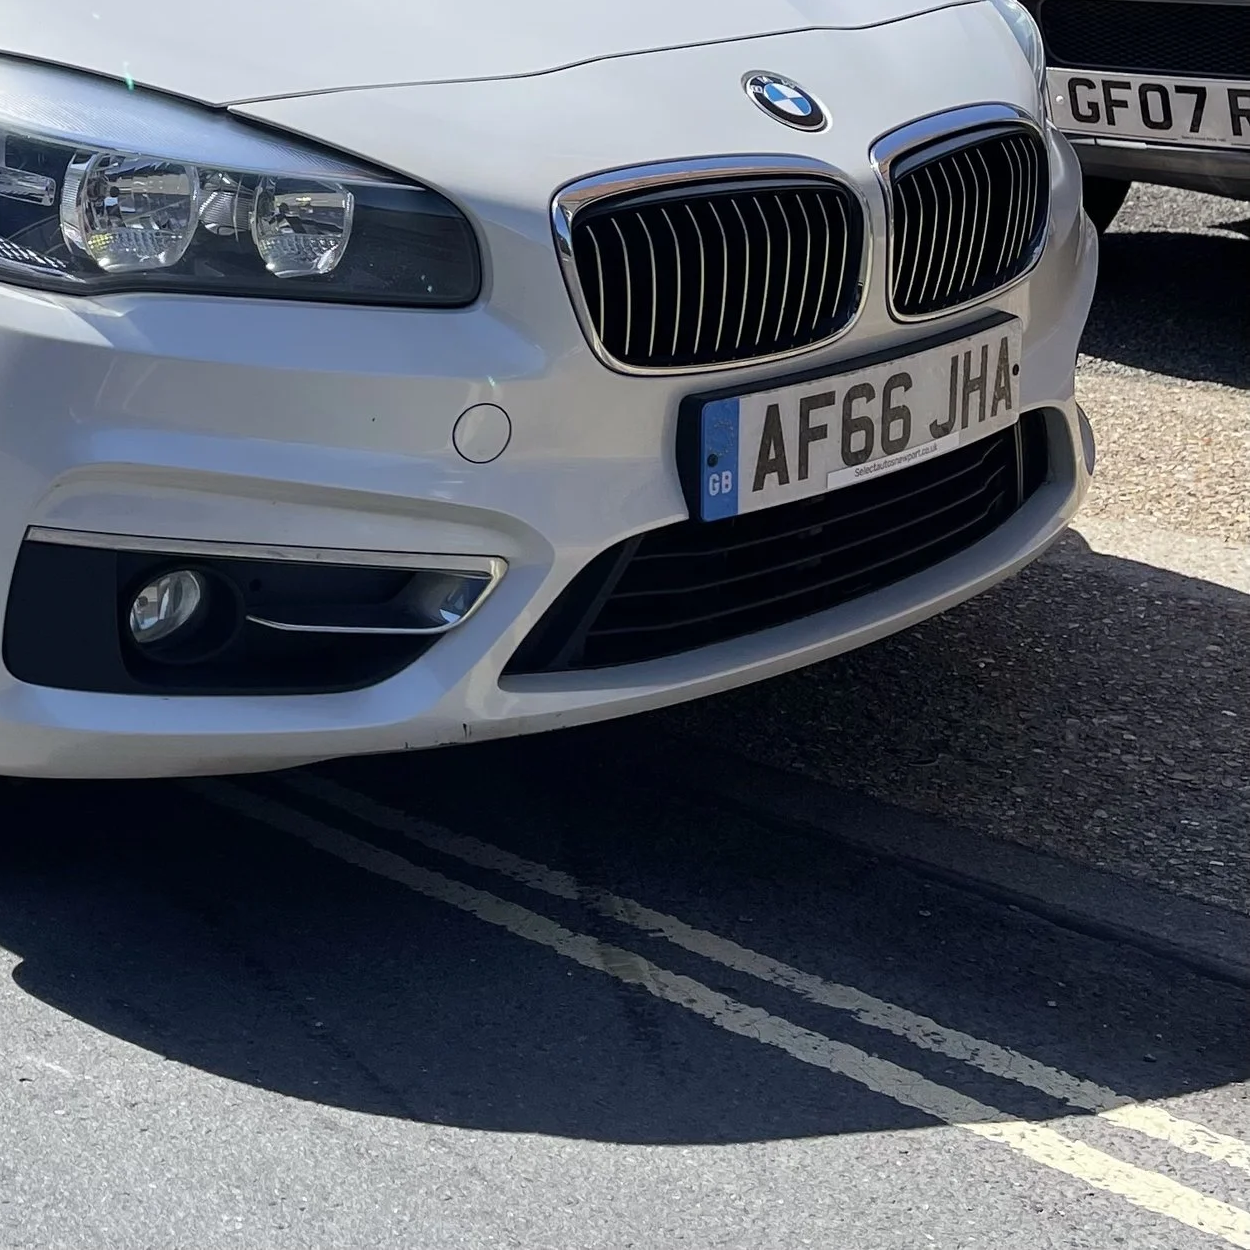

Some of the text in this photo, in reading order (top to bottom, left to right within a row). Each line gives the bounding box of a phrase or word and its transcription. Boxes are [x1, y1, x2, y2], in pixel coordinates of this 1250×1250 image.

[1067, 77, 1208, 134] GF07
[751, 336, 1013, 493] AF66 JHA
[707, 470, 734, 497] GB
